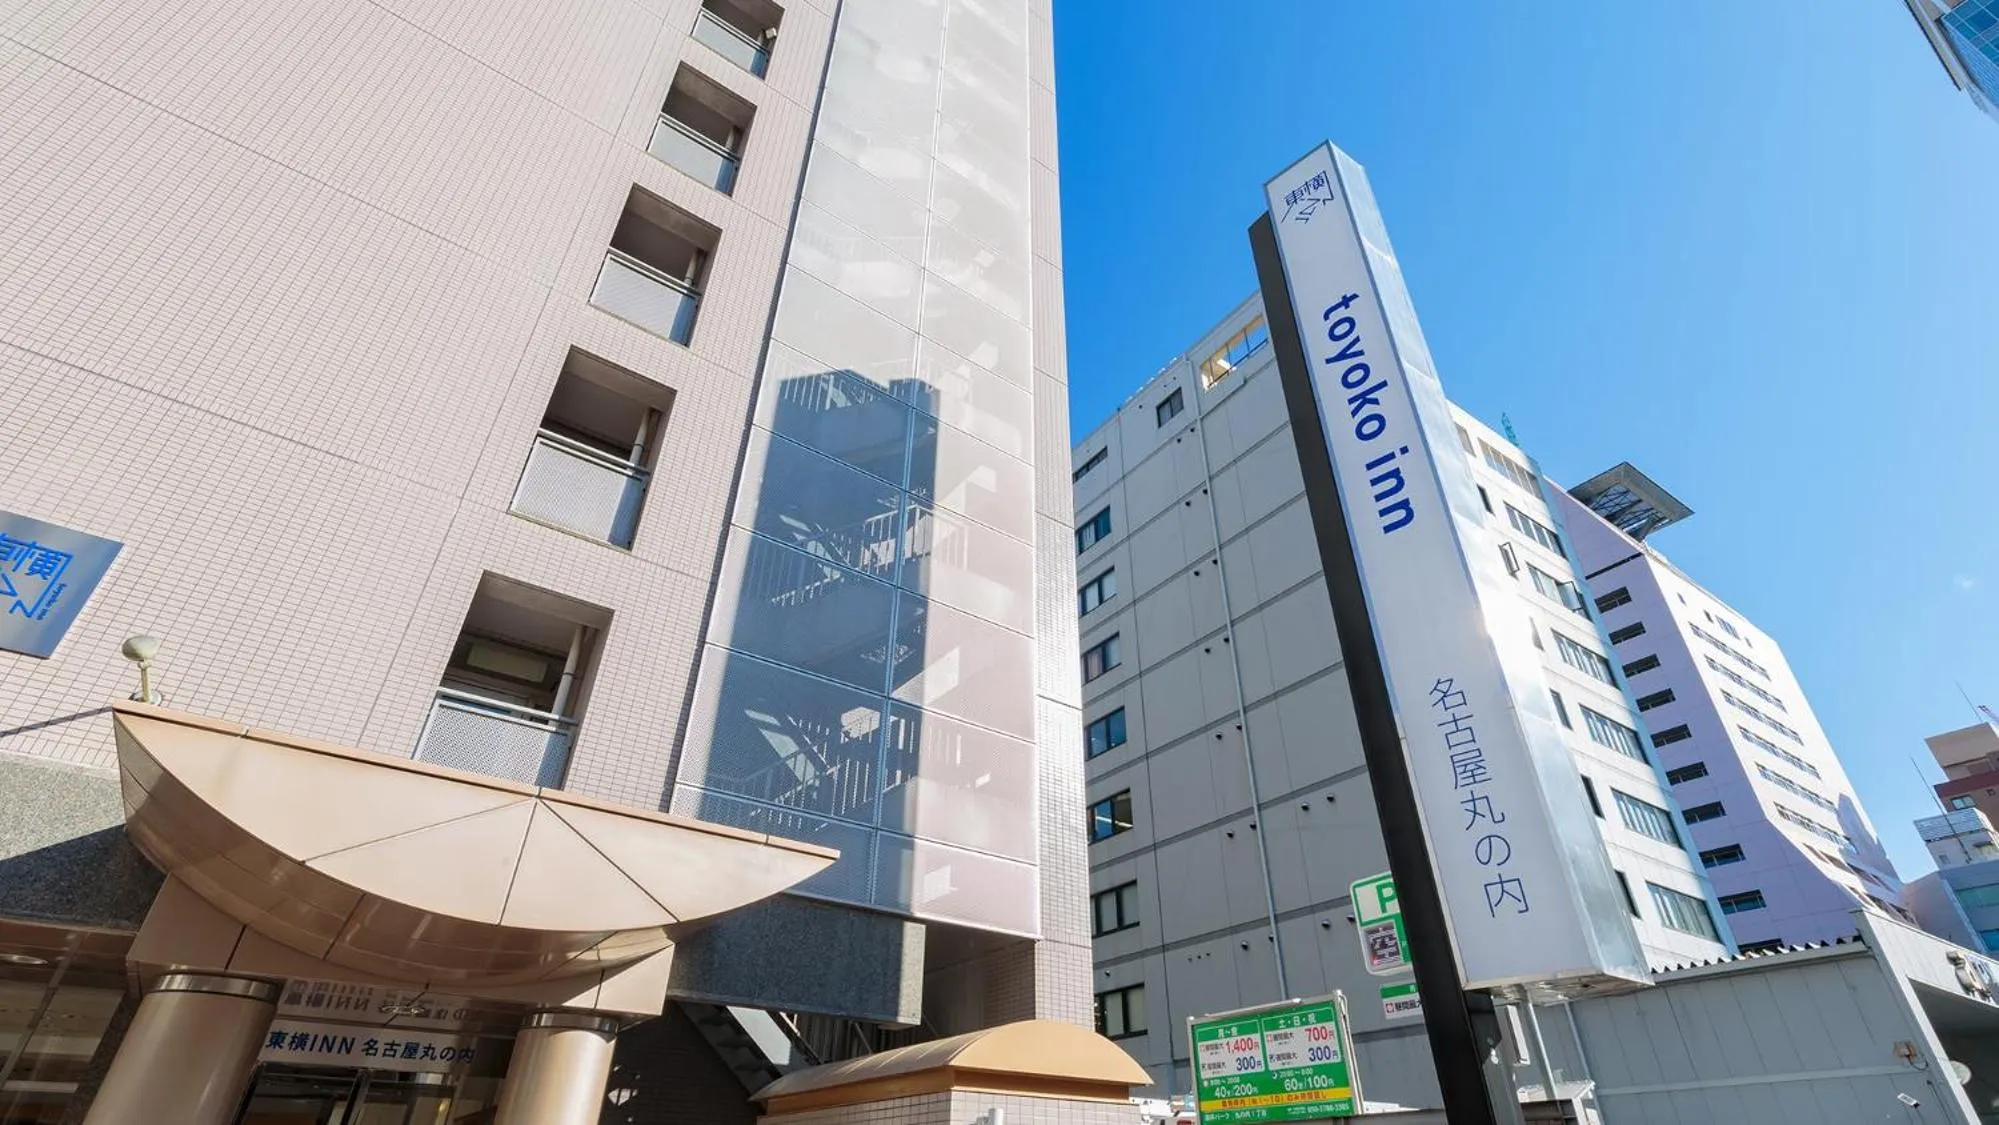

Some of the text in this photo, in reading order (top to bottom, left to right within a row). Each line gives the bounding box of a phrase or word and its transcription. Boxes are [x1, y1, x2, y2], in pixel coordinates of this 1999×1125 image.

[1323, 292, 1415, 534] toyoko inn
[1429, 677, 1529, 917] 名古屋丸の内
[1376, 882, 1397, 914] P
[265, 1030, 475, 1065] 東横INN 名古屋丸の内
[1304, 1026, 1335, 1042] 700円
[1236, 1056, 1263, 1071] 300円
[1308, 1045, 1339, 1062] 300円
